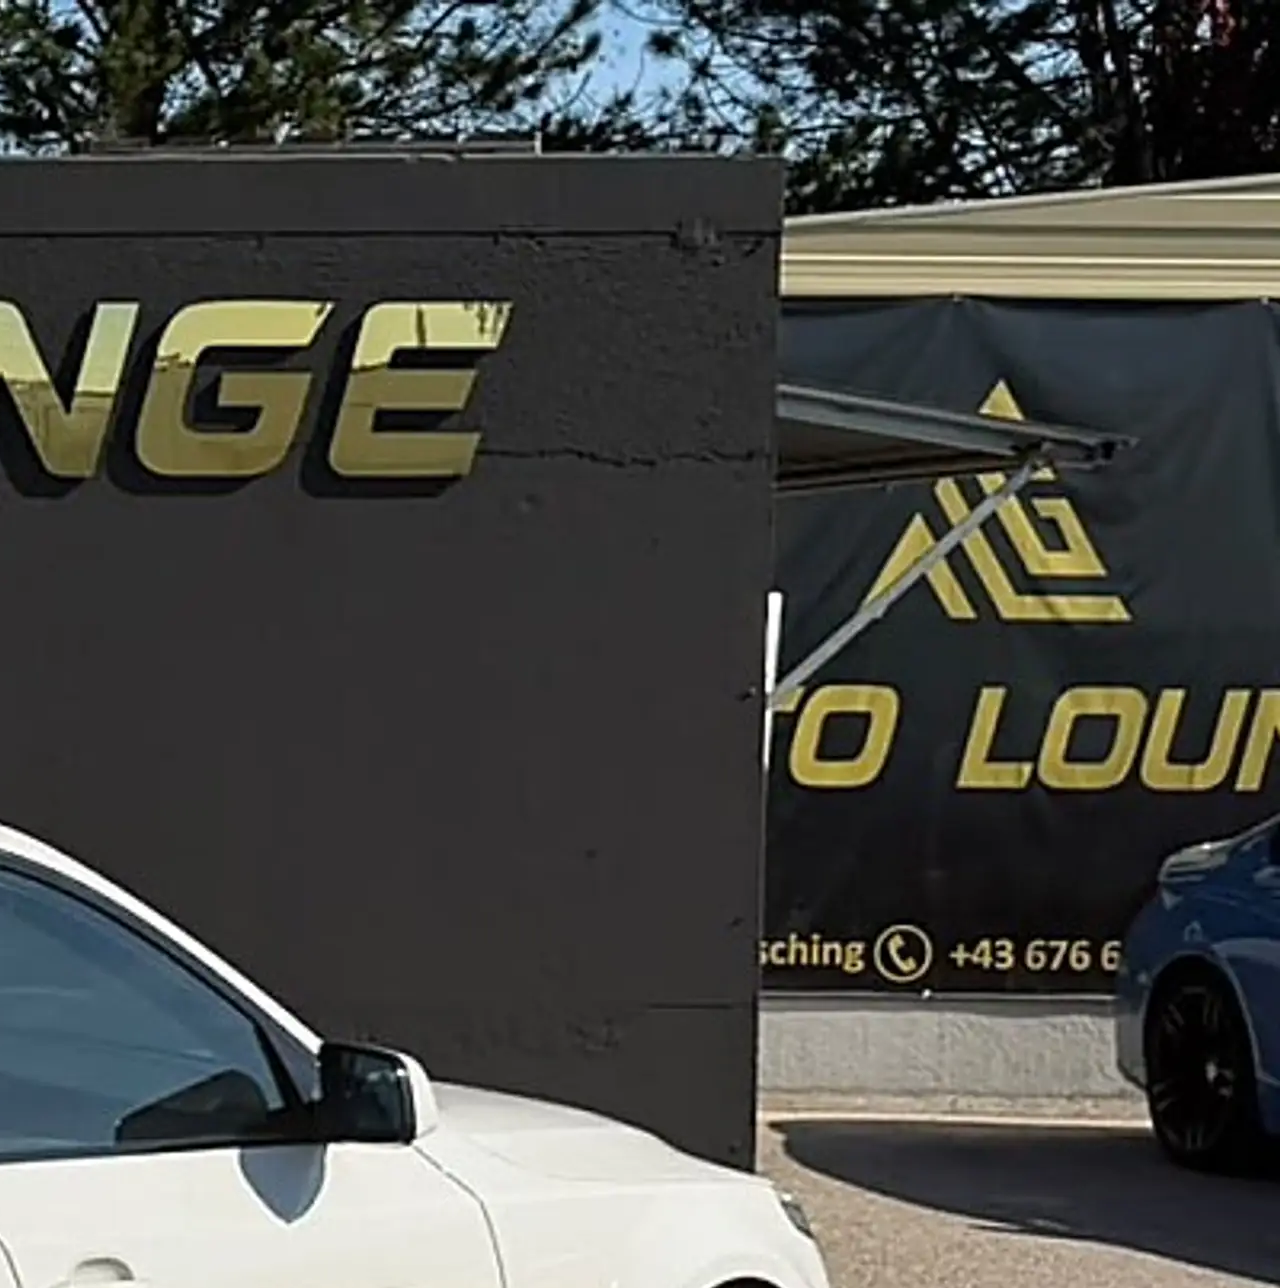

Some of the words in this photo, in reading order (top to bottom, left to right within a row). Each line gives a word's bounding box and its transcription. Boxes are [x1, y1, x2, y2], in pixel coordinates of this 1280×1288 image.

[773, 684, 900, 788] O
[949, 938, 1015, 970] +43
[1025, 940, 1092, 971] 676
